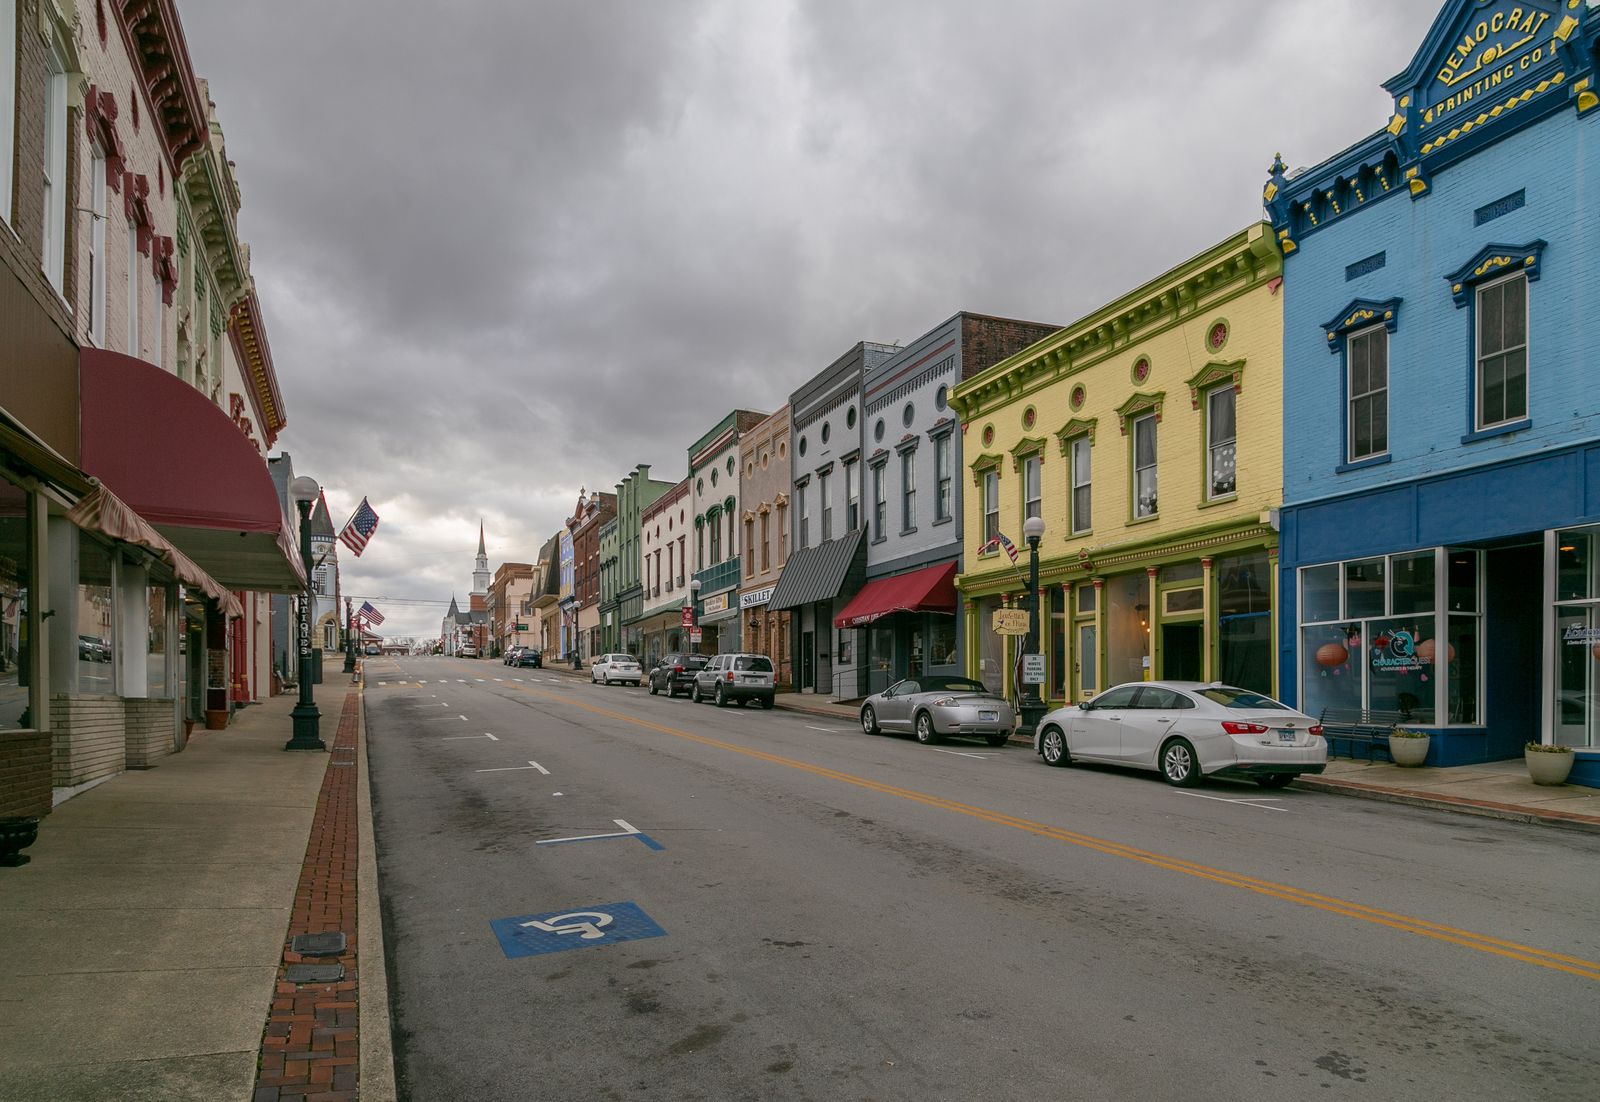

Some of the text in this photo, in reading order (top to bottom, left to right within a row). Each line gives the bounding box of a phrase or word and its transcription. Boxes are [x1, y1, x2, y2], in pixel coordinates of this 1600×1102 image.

[1437, 8, 1549, 84] DEMOCRAT
[1437, 65, 1514, 117] PRINTING
[300, 590, 309, 655] ANTIQUES
[744, 589, 770, 606] SKILLET
